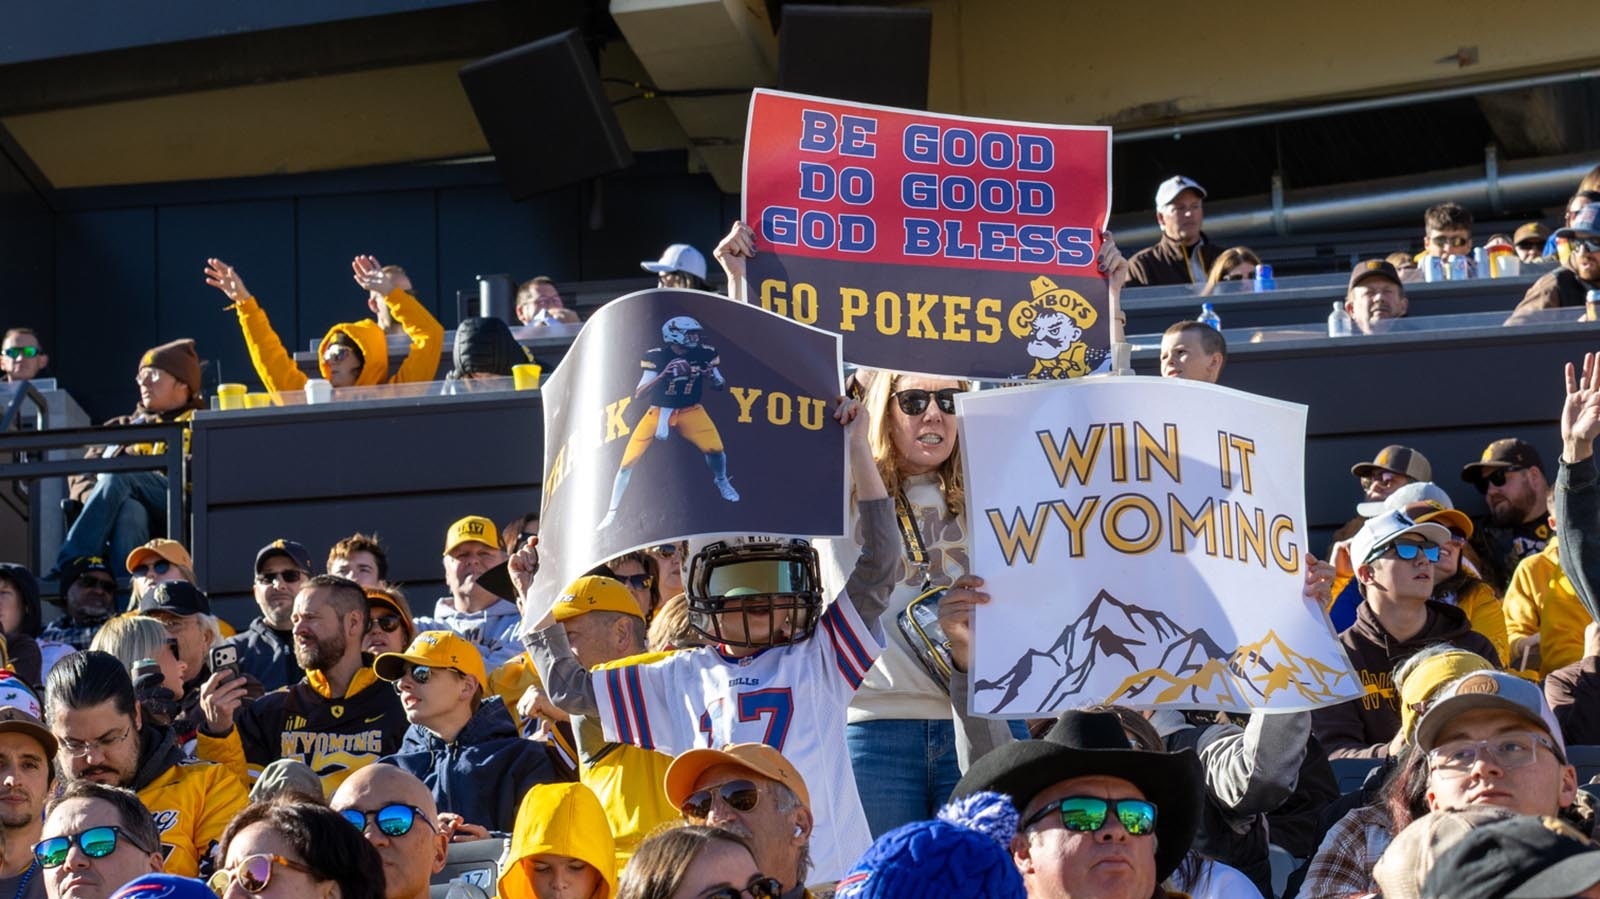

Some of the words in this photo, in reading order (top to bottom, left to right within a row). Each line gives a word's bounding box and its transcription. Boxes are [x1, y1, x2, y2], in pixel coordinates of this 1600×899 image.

[800, 109, 877, 158] BE
[903, 124, 1054, 173] GOOD
[799, 162, 874, 206] DO
[901, 172, 1055, 215] GOOD
[761, 206, 876, 253] GOD
[903, 218, 1095, 266] BLESS
[760, 279, 818, 325] GO
[839, 287, 1003, 344] POKES
[1016, 294, 1092, 329] COWBOYS
[543, 396, 632, 513] THAK
[729, 386, 826, 431] YOU
[1035, 421, 1182, 488] WIN
[1217, 429, 1256, 495] IT
[985, 492, 1300, 576] WYOMING
[281, 729, 383, 758] WYOMING
